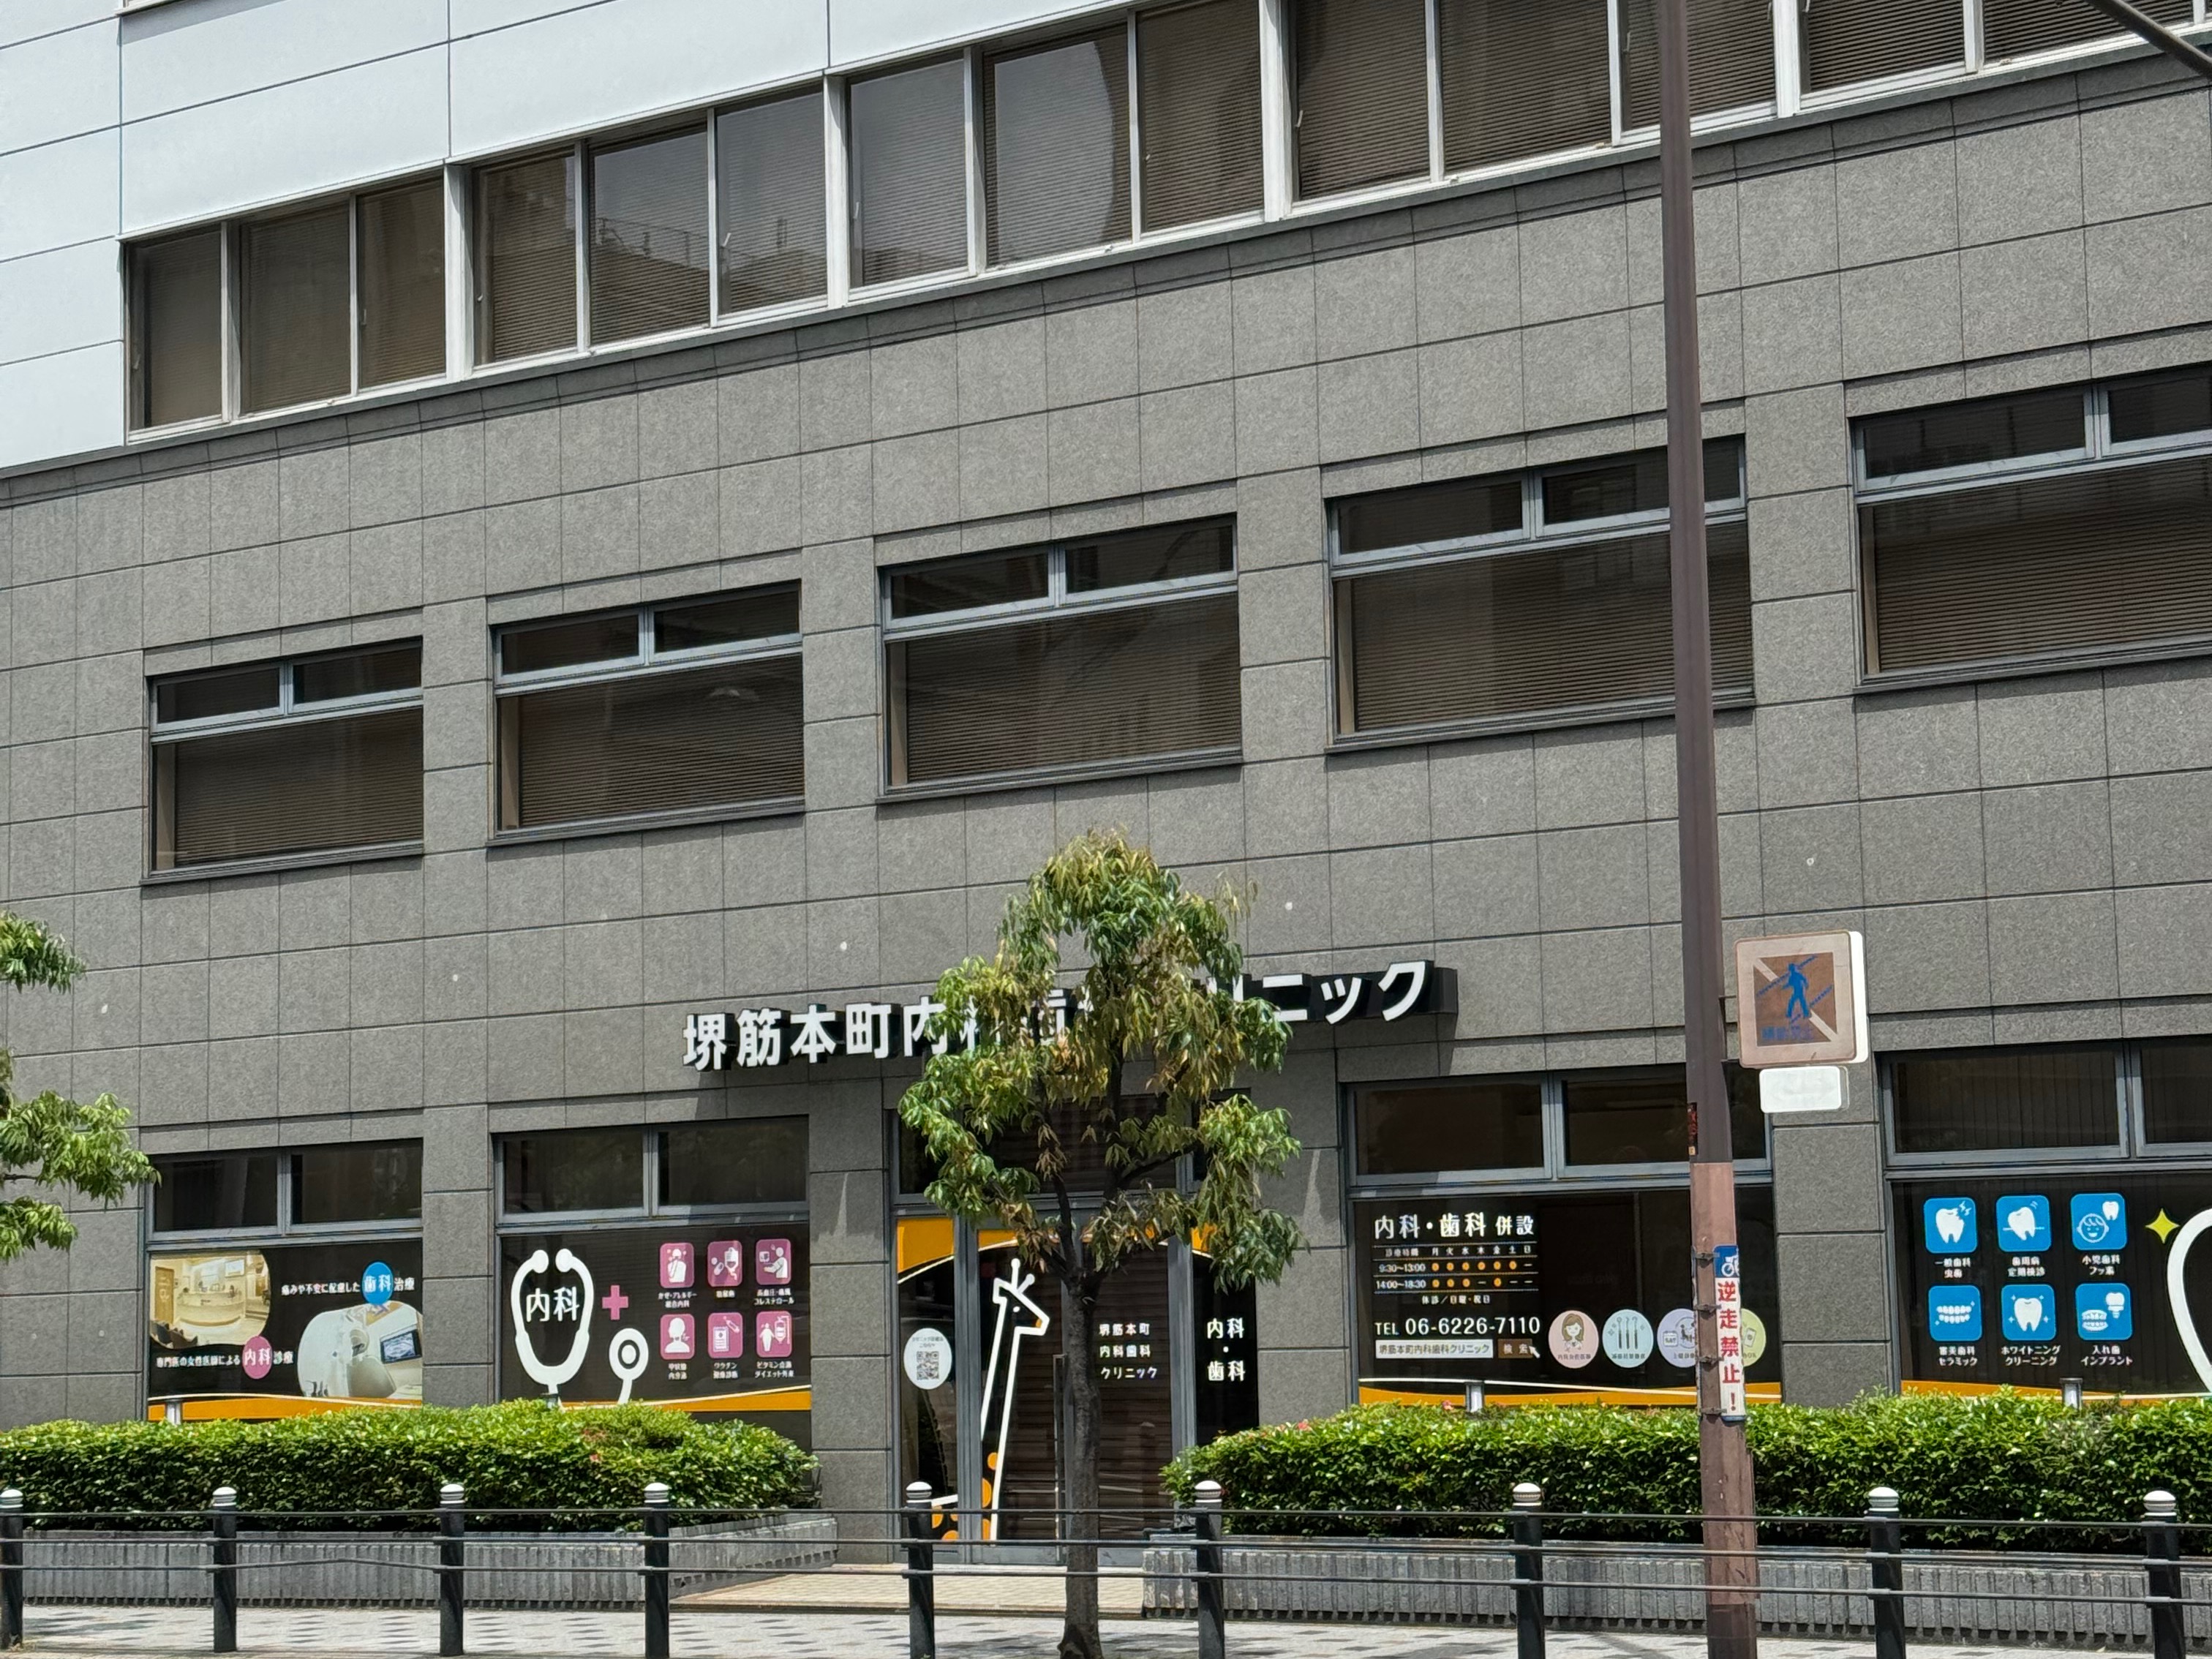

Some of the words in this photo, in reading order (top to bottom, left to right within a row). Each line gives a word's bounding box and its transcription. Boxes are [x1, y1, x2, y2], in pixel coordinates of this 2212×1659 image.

[1374, 1211, 1486, 1240] 内科・歯科
[1495, 1215, 1534, 1236] 併設
[1432, 1246, 1439, 1256] 月
[1445, 1246, 1453, 1256] 火
[1462, 1246, 1470, 1255] 水
[1477, 1246, 1485, 1255] 木
[1492, 1245, 1500, 1254] 金
[1508, 1245, 1516, 1254] 土
[1524, 1244, 1531, 1254] 日
[526, 1285, 579, 1323] 内科
[1099, 1323, 1150, 1337] 堺筋本町
[1206, 1317, 1245, 1339] 内科
[1374, 1322, 1399, 1336] TEL
[1404, 1316, 1540, 1336] 06-6226-7110
[1099, 1344, 1151, 1358] 内科歯科
[1379, 1343, 1491, 1354] 堺筋本町内科歯科クリニック
[2001, 1344, 2061, 1355] ホワイトニング
[1938, 1357, 1978, 1367] セラミック
[2005, 1356, 2057, 1367] クリーニング
[2080, 1357, 2134, 1367] インプラント
[1100, 1366, 1158, 1380] クリニック
[1206, 1360, 1246, 1382] 歯科
